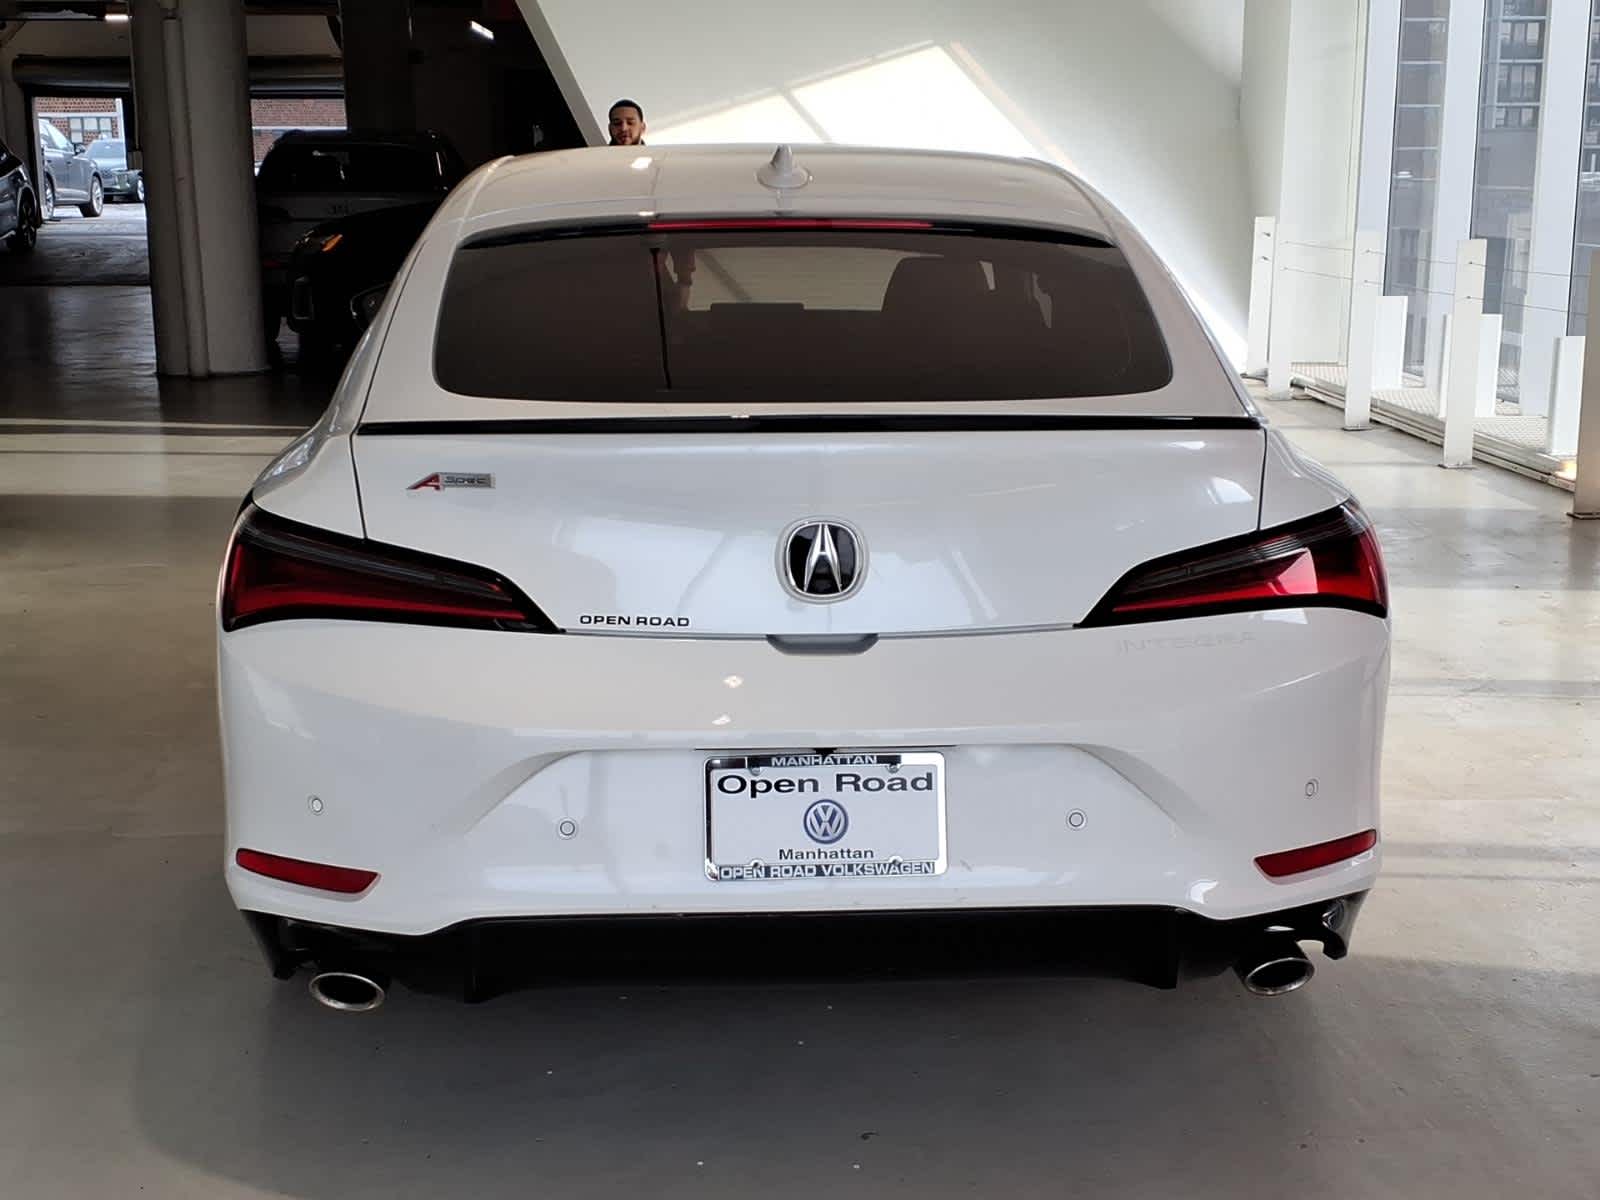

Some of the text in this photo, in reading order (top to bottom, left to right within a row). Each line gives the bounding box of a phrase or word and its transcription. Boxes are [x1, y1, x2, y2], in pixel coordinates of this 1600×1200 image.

[579, 615, 690, 627] OPEN ROAD
[770, 755, 878, 768] MANHATTAN
[717, 772, 933, 799] Open Road
[778, 848, 875, 861] Manhattan
[720, 861, 935, 879] OPEN ROAD VOLKSWAGEN
